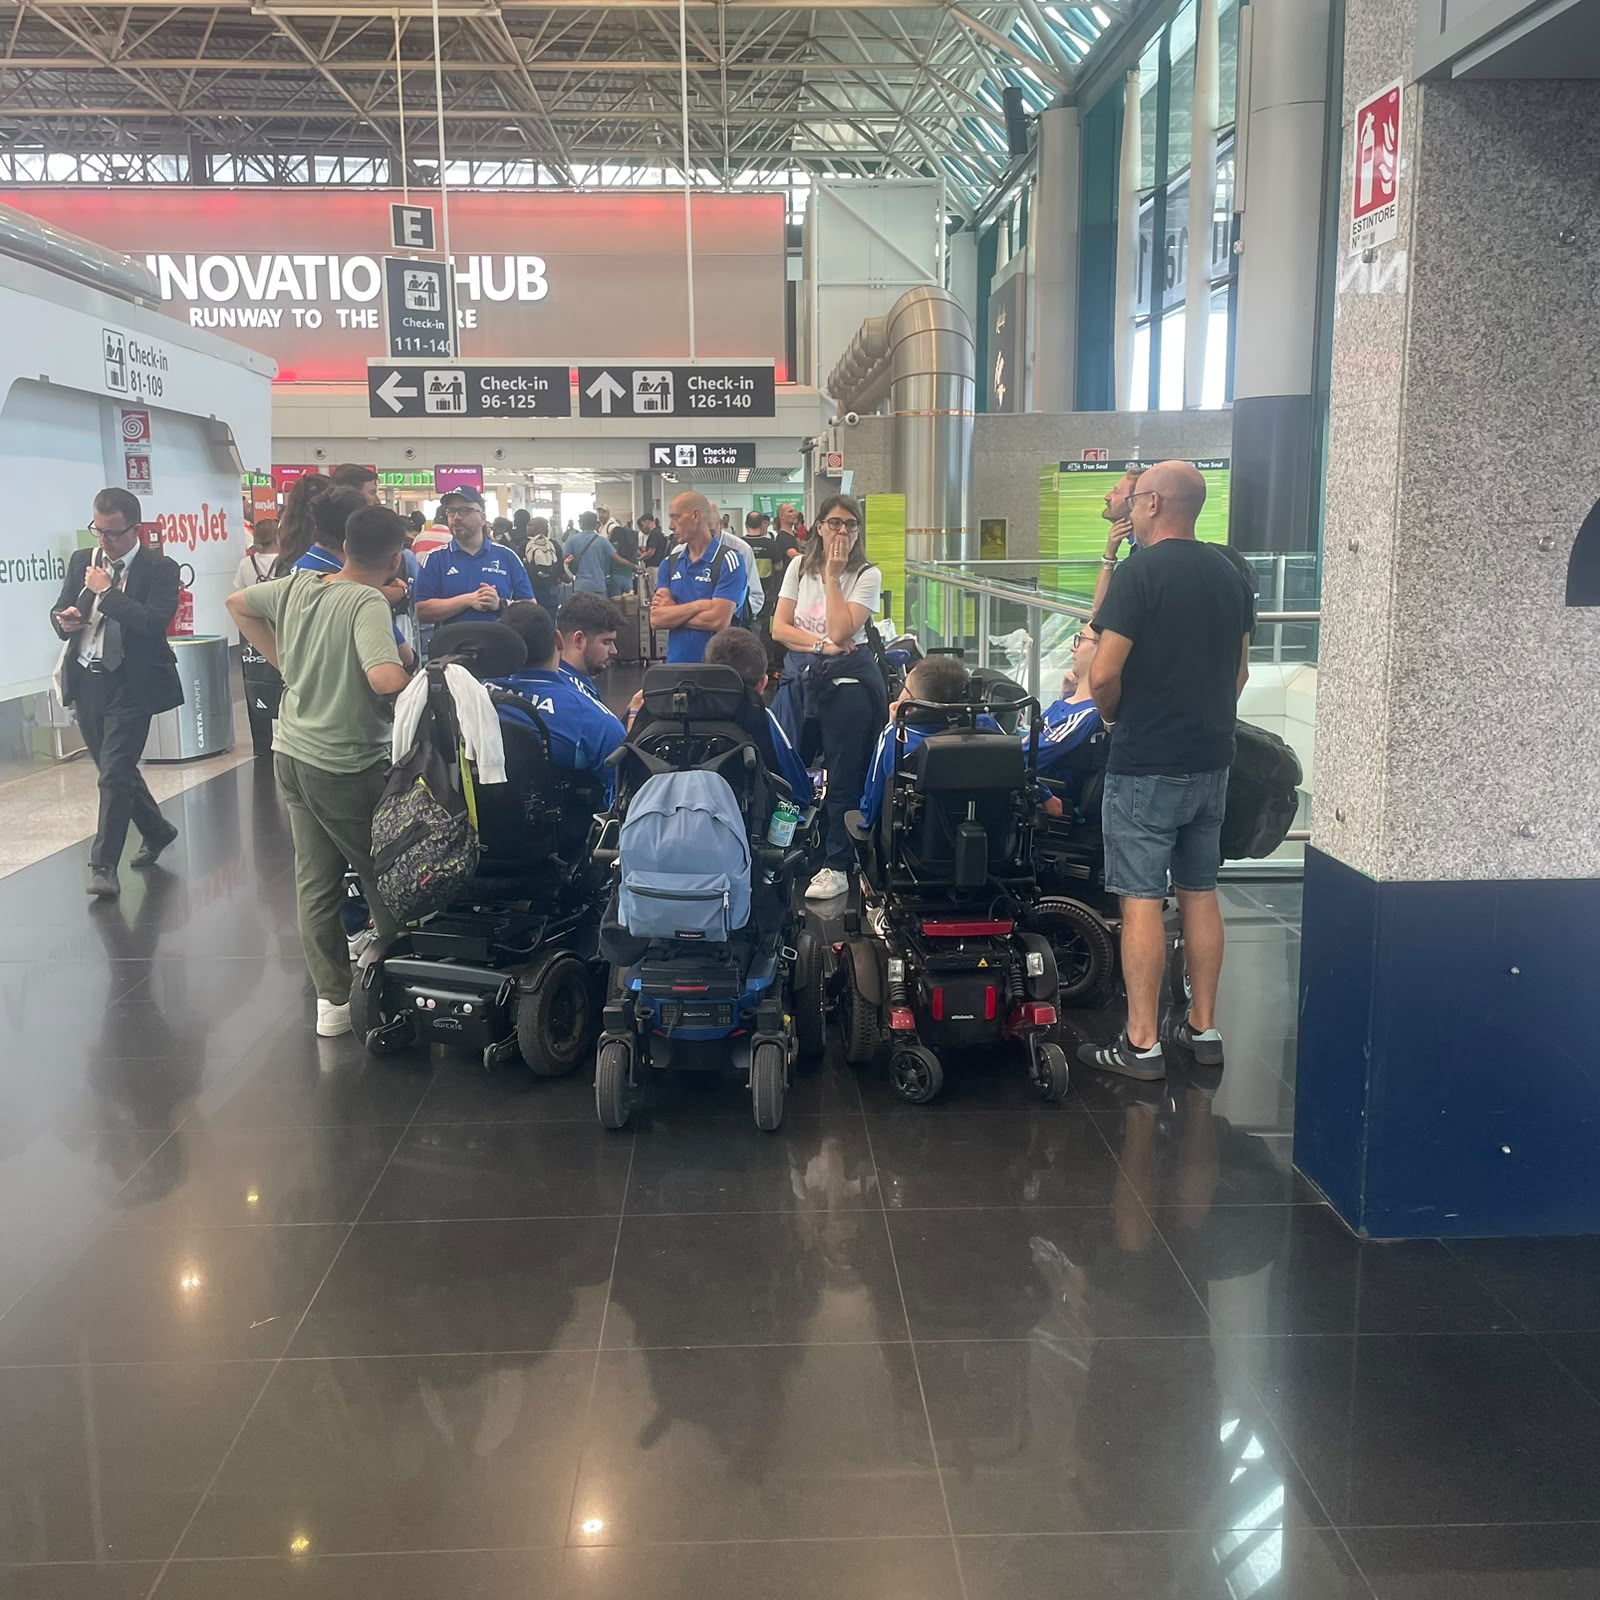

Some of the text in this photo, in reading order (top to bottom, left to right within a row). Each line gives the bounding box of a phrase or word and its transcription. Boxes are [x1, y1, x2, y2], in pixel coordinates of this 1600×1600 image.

[1352, 204, 1395, 235] ESTINTORE
[403, 210, 424, 246] E
[146, 254, 549, 302] NOVATIO HUB
[189, 307, 380, 329] RUNWAY TO THE
[402, 317, 445, 330] Check-in
[128, 340, 169, 372] Check-in
[130, 370, 163, 397] 81-109
[480, 376, 549, 391] Check-in
[687, 376, 754, 391] Check-in
[481, 395, 536, 409] 96-125
[689, 395, 751, 408] 126-140
[702, 447, 737, 456] Check-in
[703, 456, 736, 465] 126-140
[381, 473, 404, 487] 112
[409, 473, 432, 487] 111
[156, 503, 228, 551] easyJet
[795, 614, 827, 634] adid
